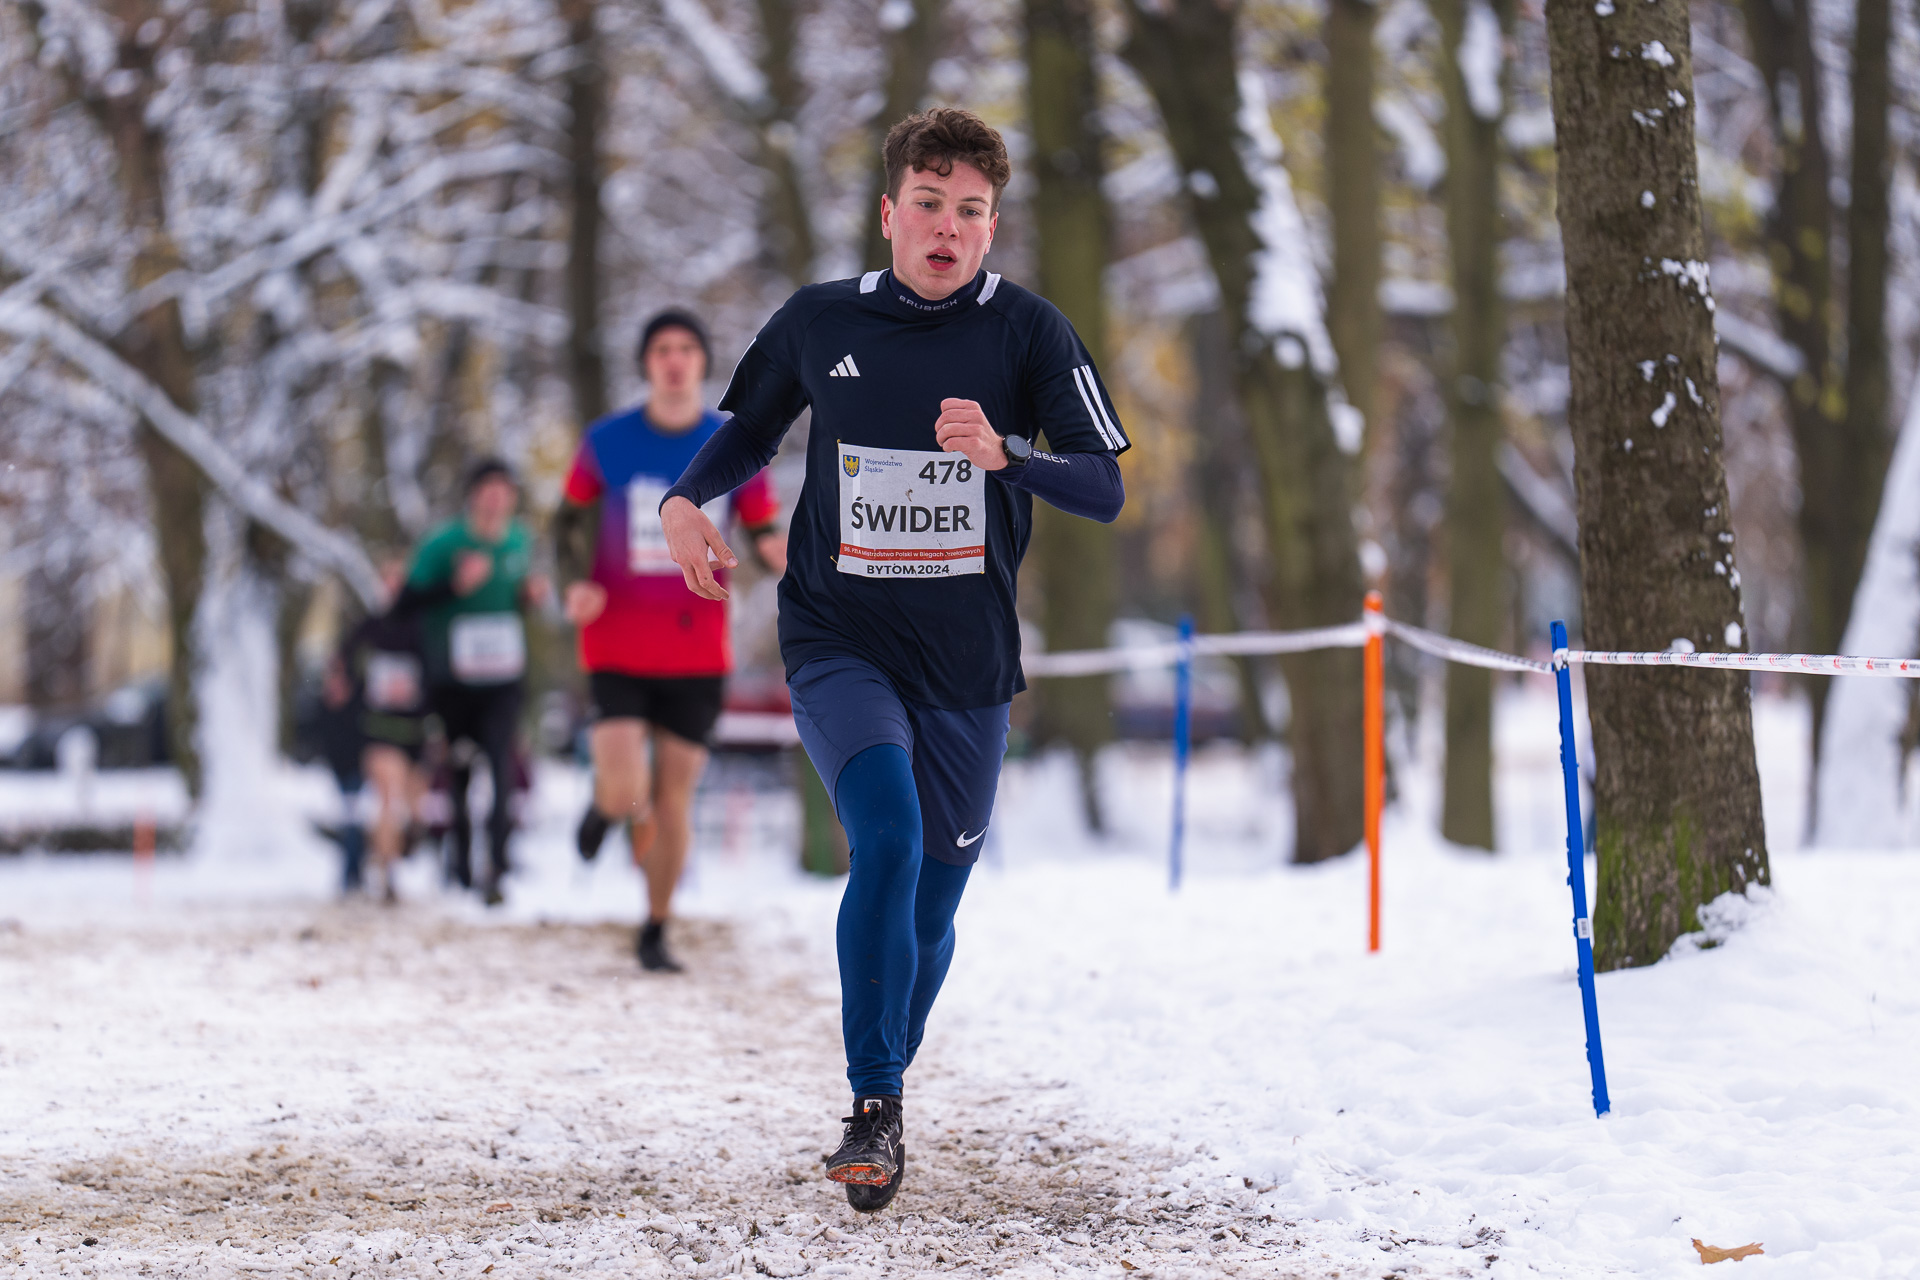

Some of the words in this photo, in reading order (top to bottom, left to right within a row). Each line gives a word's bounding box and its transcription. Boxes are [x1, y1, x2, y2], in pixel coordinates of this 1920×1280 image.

[899, 295, 957, 311] BRUBECK
[864, 458, 903, 467] Województwo
[864, 465, 884, 473] Śląskie
[918, 459, 972, 484] 478
[851, 496, 973, 533] ŚWIDER
[866, 564, 916, 575] BYTOM
[917, 564, 950, 575] 2024
